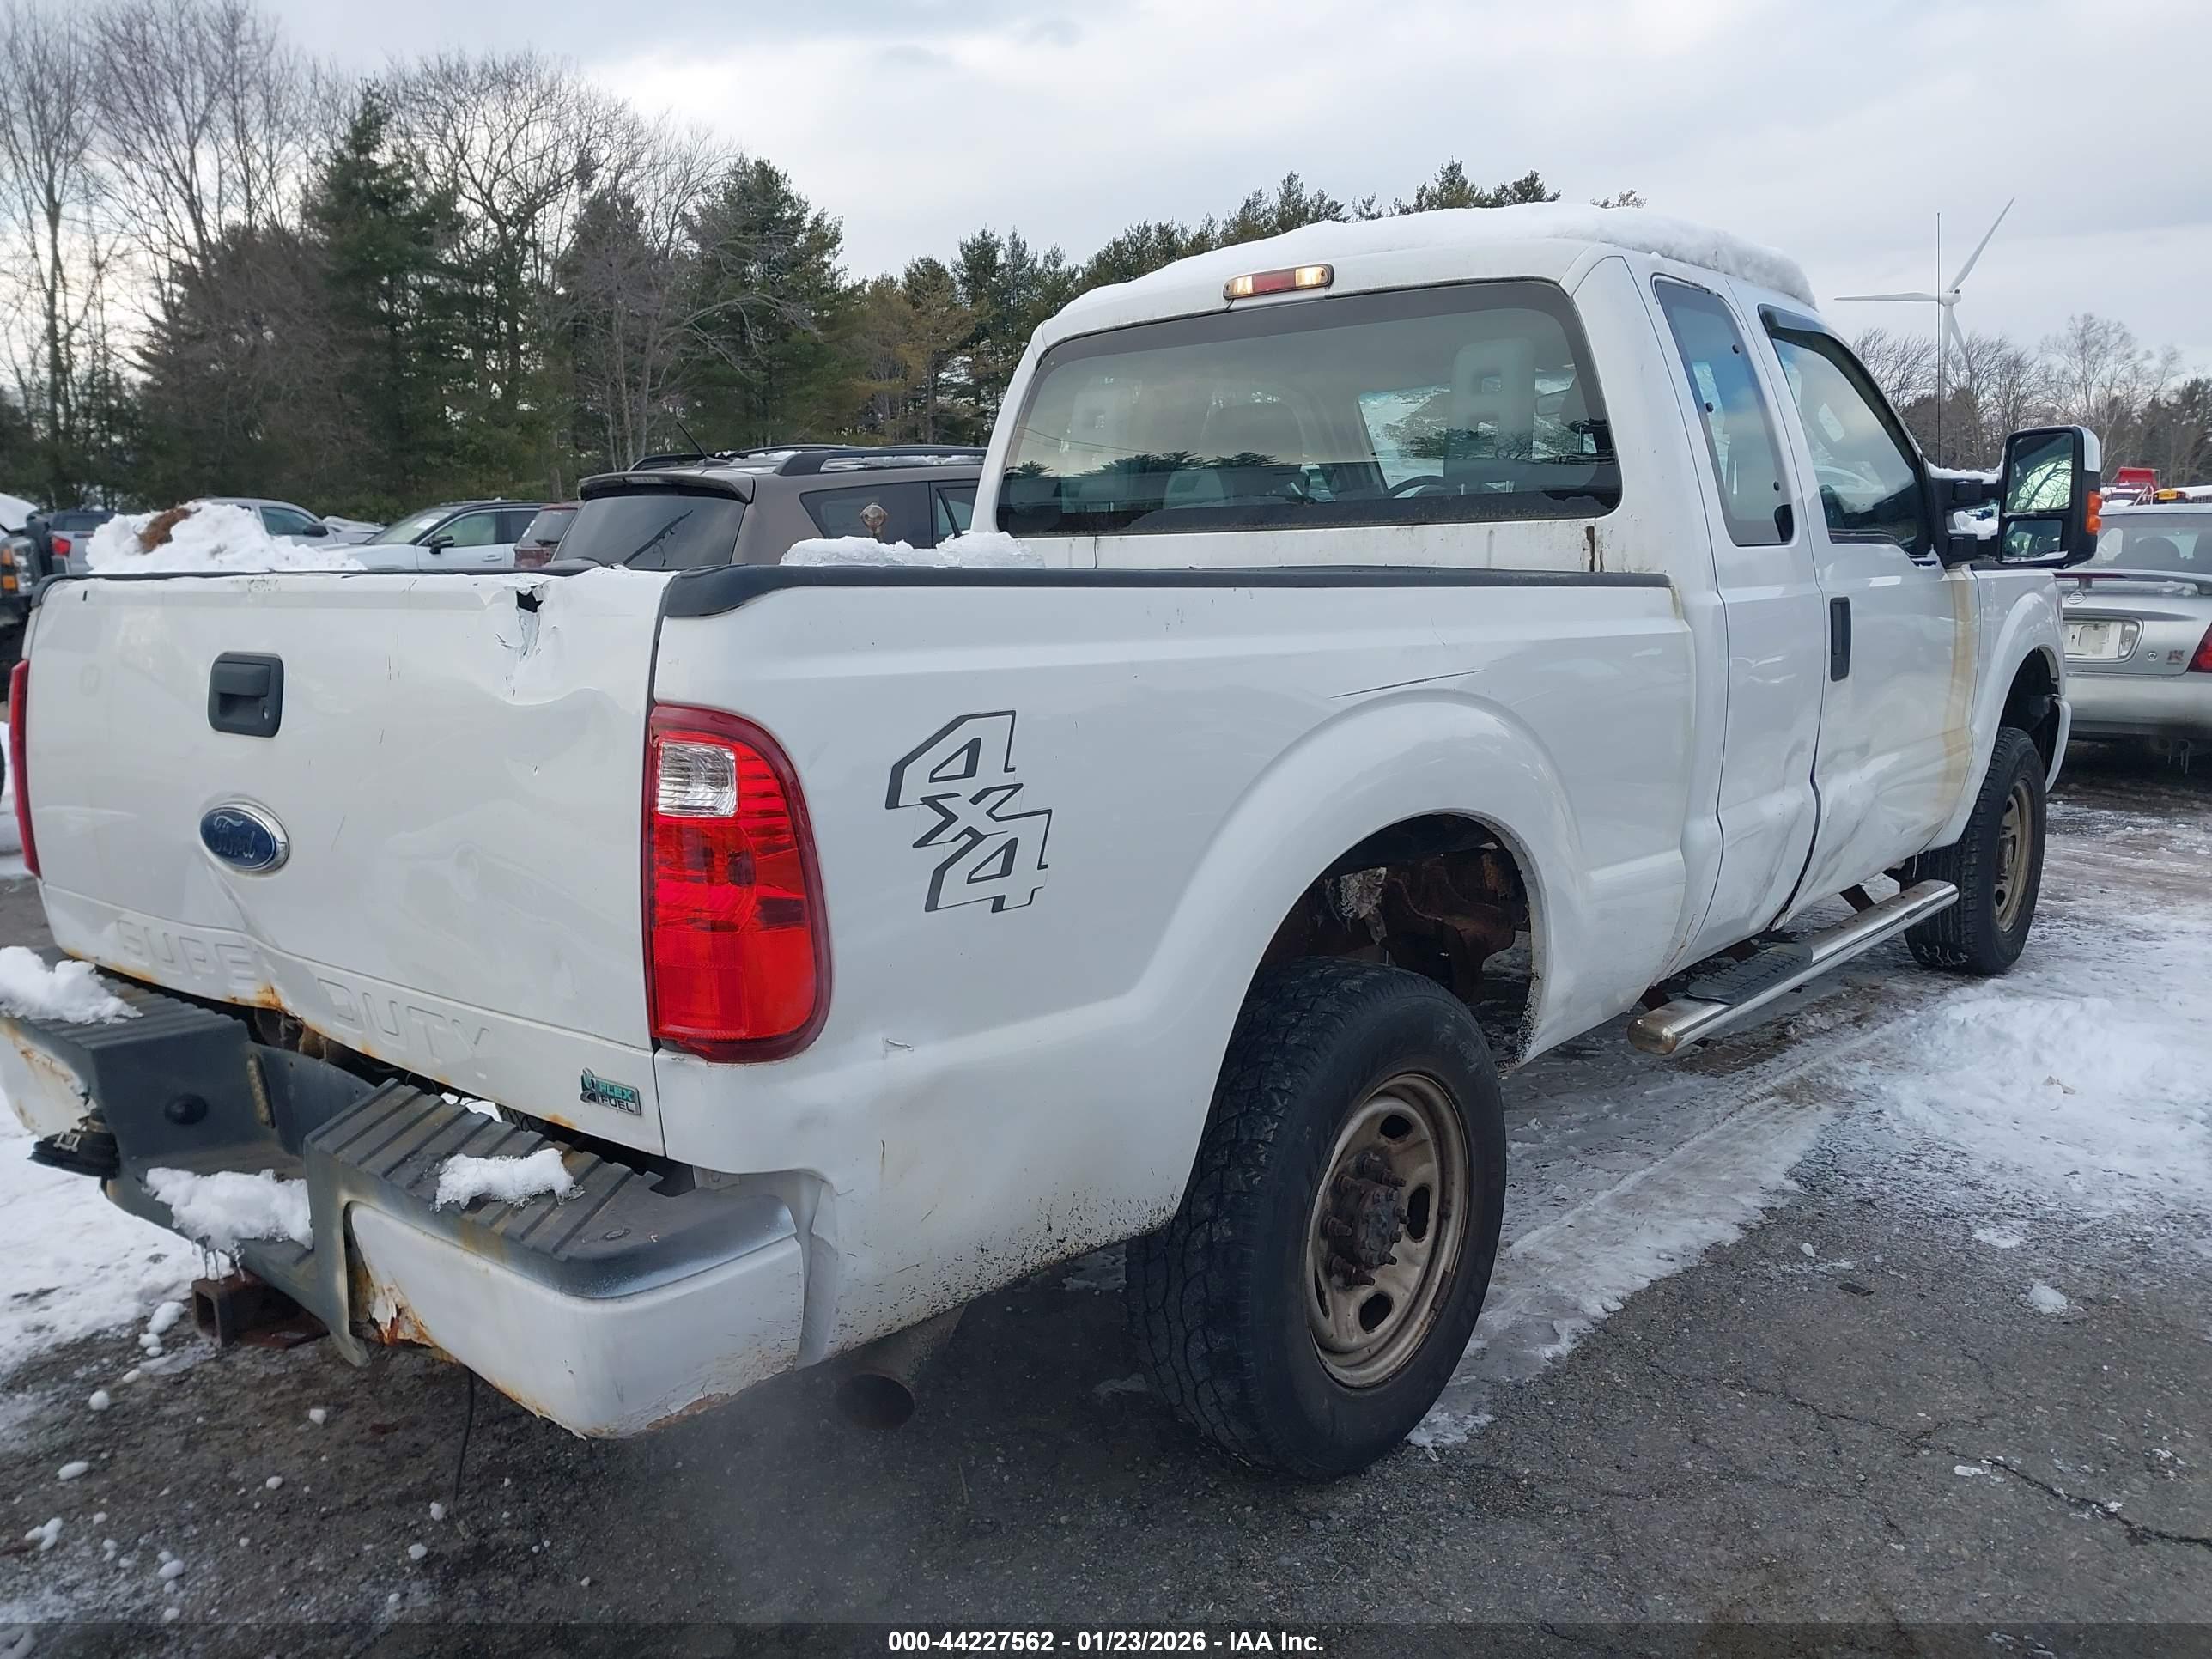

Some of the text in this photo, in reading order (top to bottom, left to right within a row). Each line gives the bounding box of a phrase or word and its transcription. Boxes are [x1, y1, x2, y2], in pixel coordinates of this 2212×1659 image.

[213, 814, 257, 859] Ford
[115, 918, 491, 1079] SUPE DUTY
[599, 1082, 633, 1102] FLEX
[601, 1094, 635, 1114] FUEL
